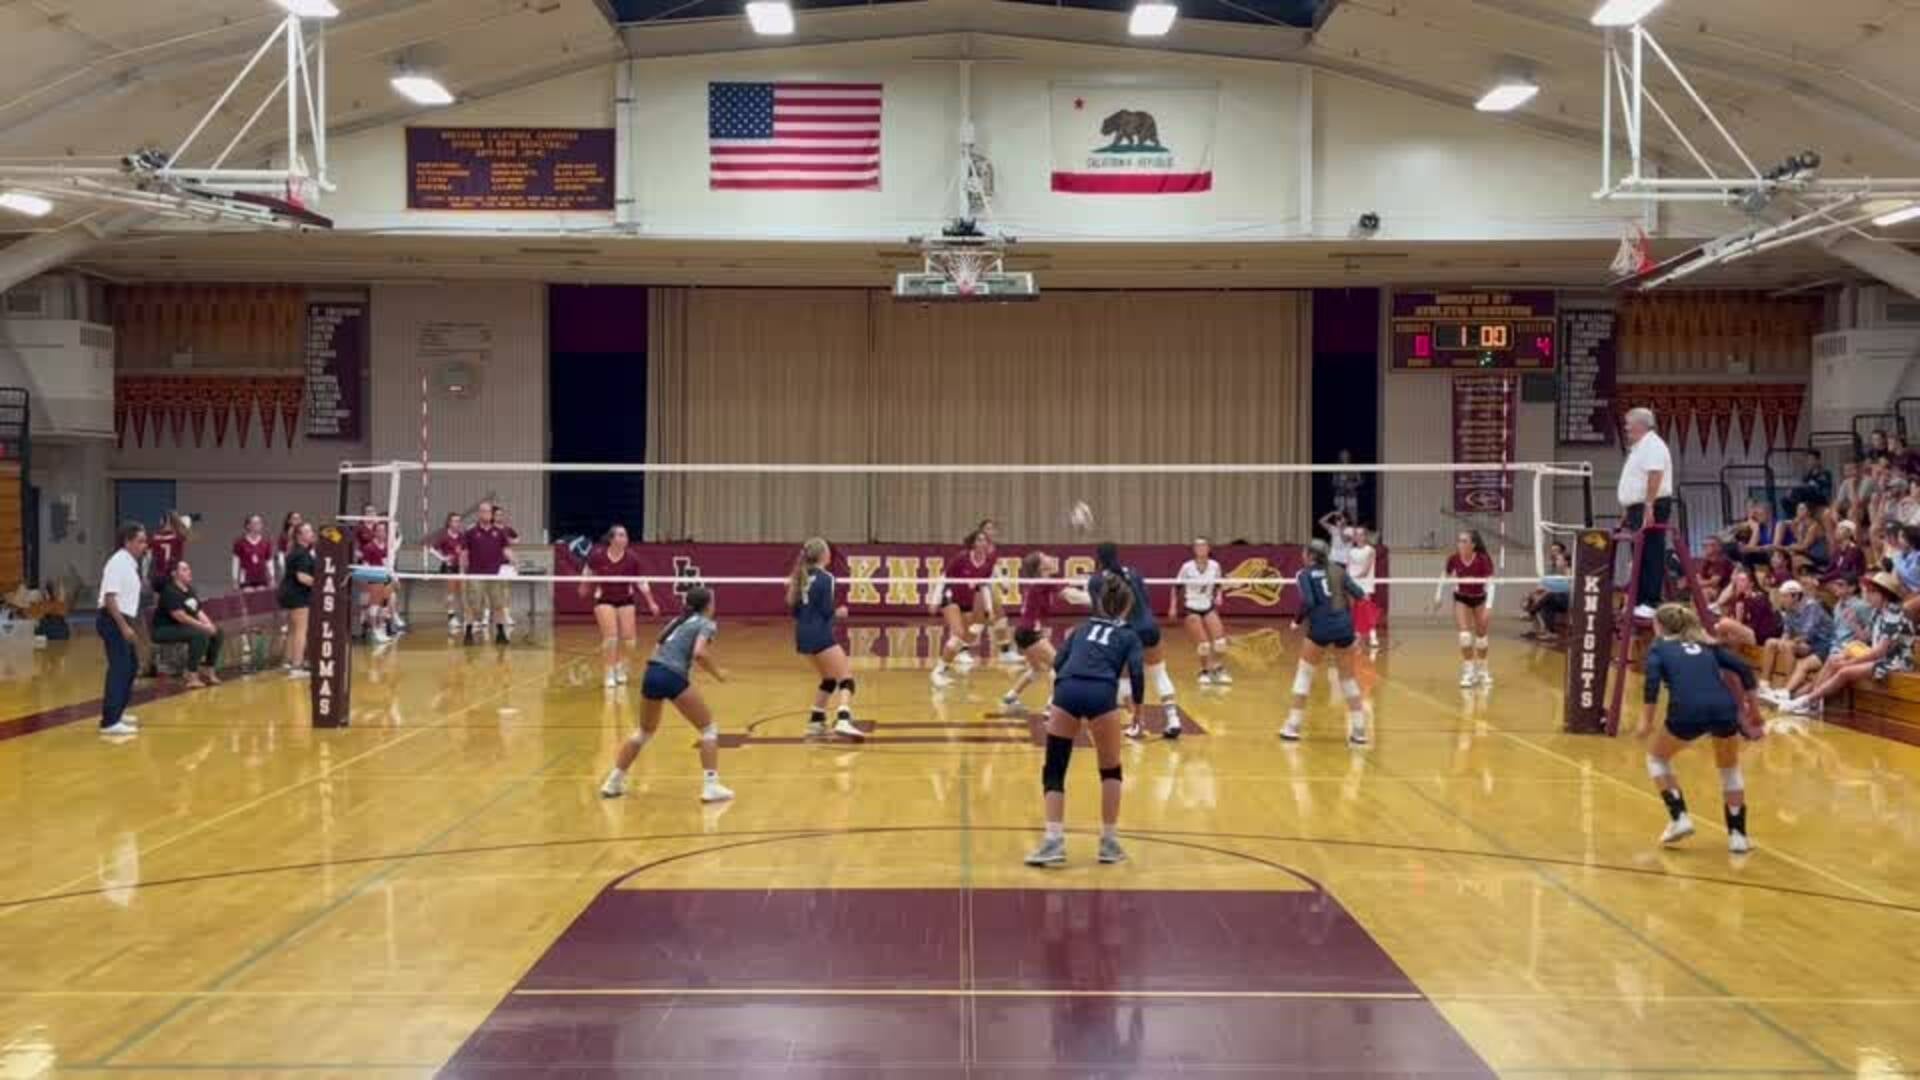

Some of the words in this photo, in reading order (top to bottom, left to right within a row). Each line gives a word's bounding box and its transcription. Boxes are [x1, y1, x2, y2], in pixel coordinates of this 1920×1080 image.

[322, 556, 336, 612] LAS
[319, 621, 335, 715] LOMAS
[1087, 624, 1114, 645] 11
[1581, 576, 1599, 708] KNIGHTS
